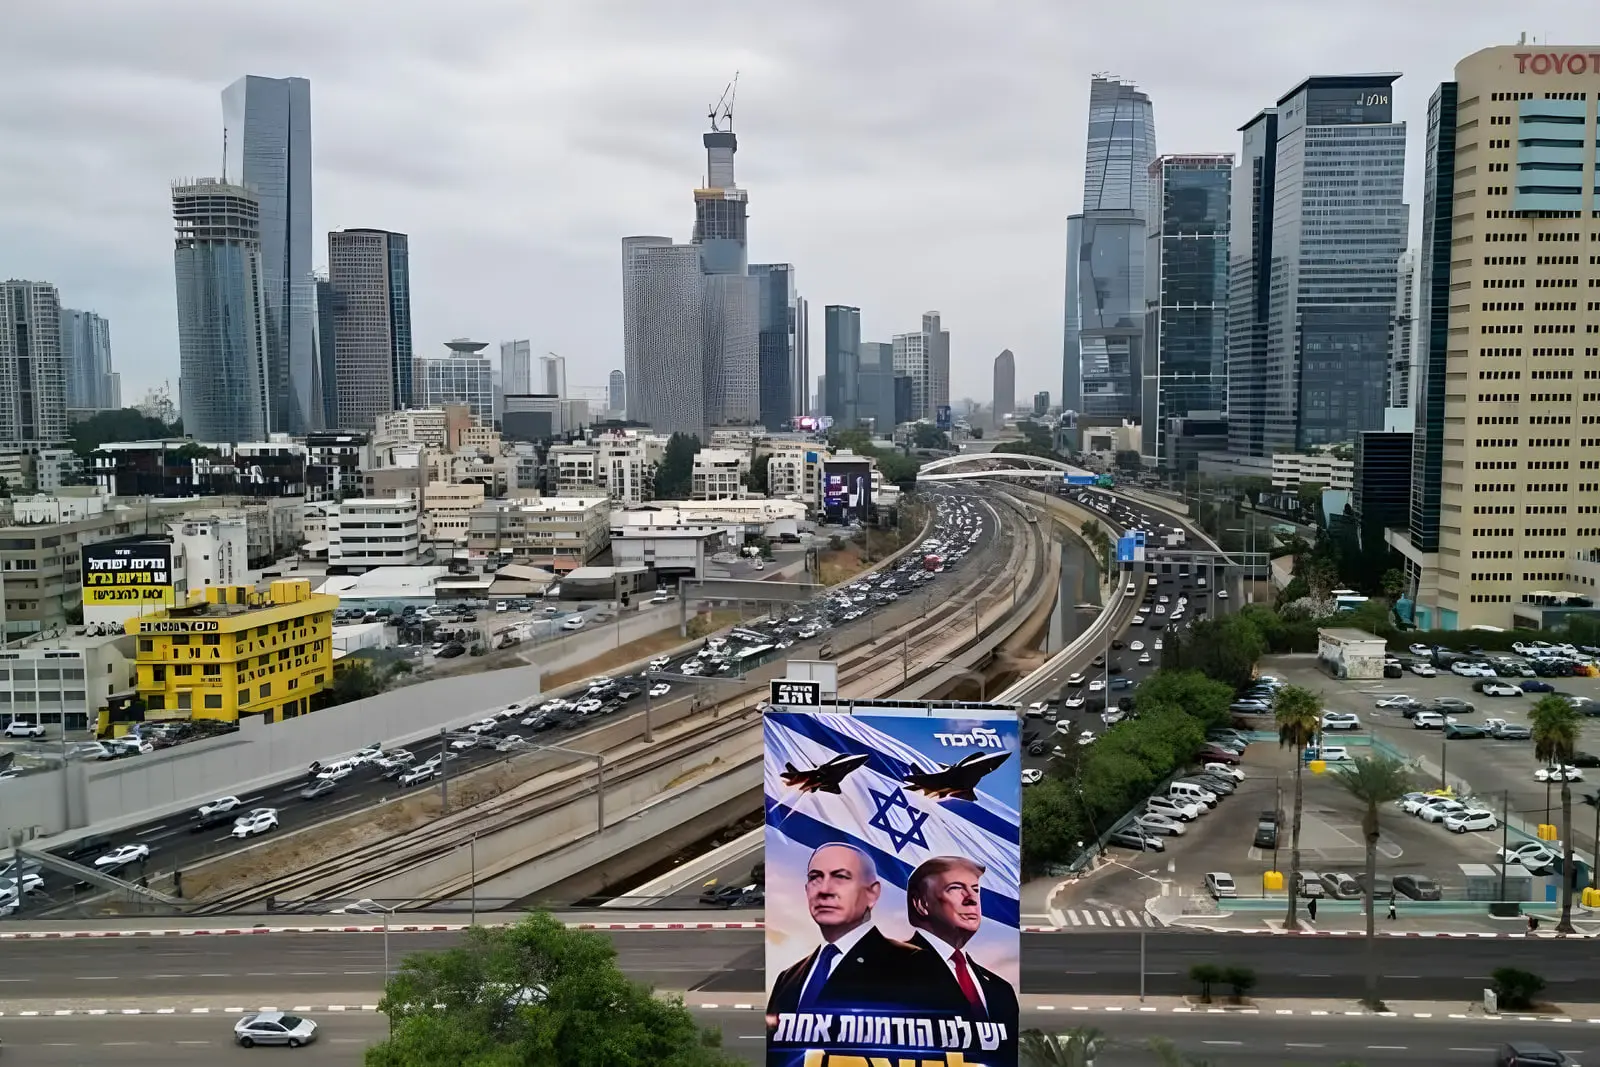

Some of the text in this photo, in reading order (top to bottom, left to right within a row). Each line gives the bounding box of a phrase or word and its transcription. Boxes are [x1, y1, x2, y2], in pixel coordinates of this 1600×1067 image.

[1513, 53, 1600, 75] TOYOT
[773, 1013, 833, 1043] אחת
[938, 1015, 972, 1049] לנו
[975, 1021, 1008, 1051] יש
